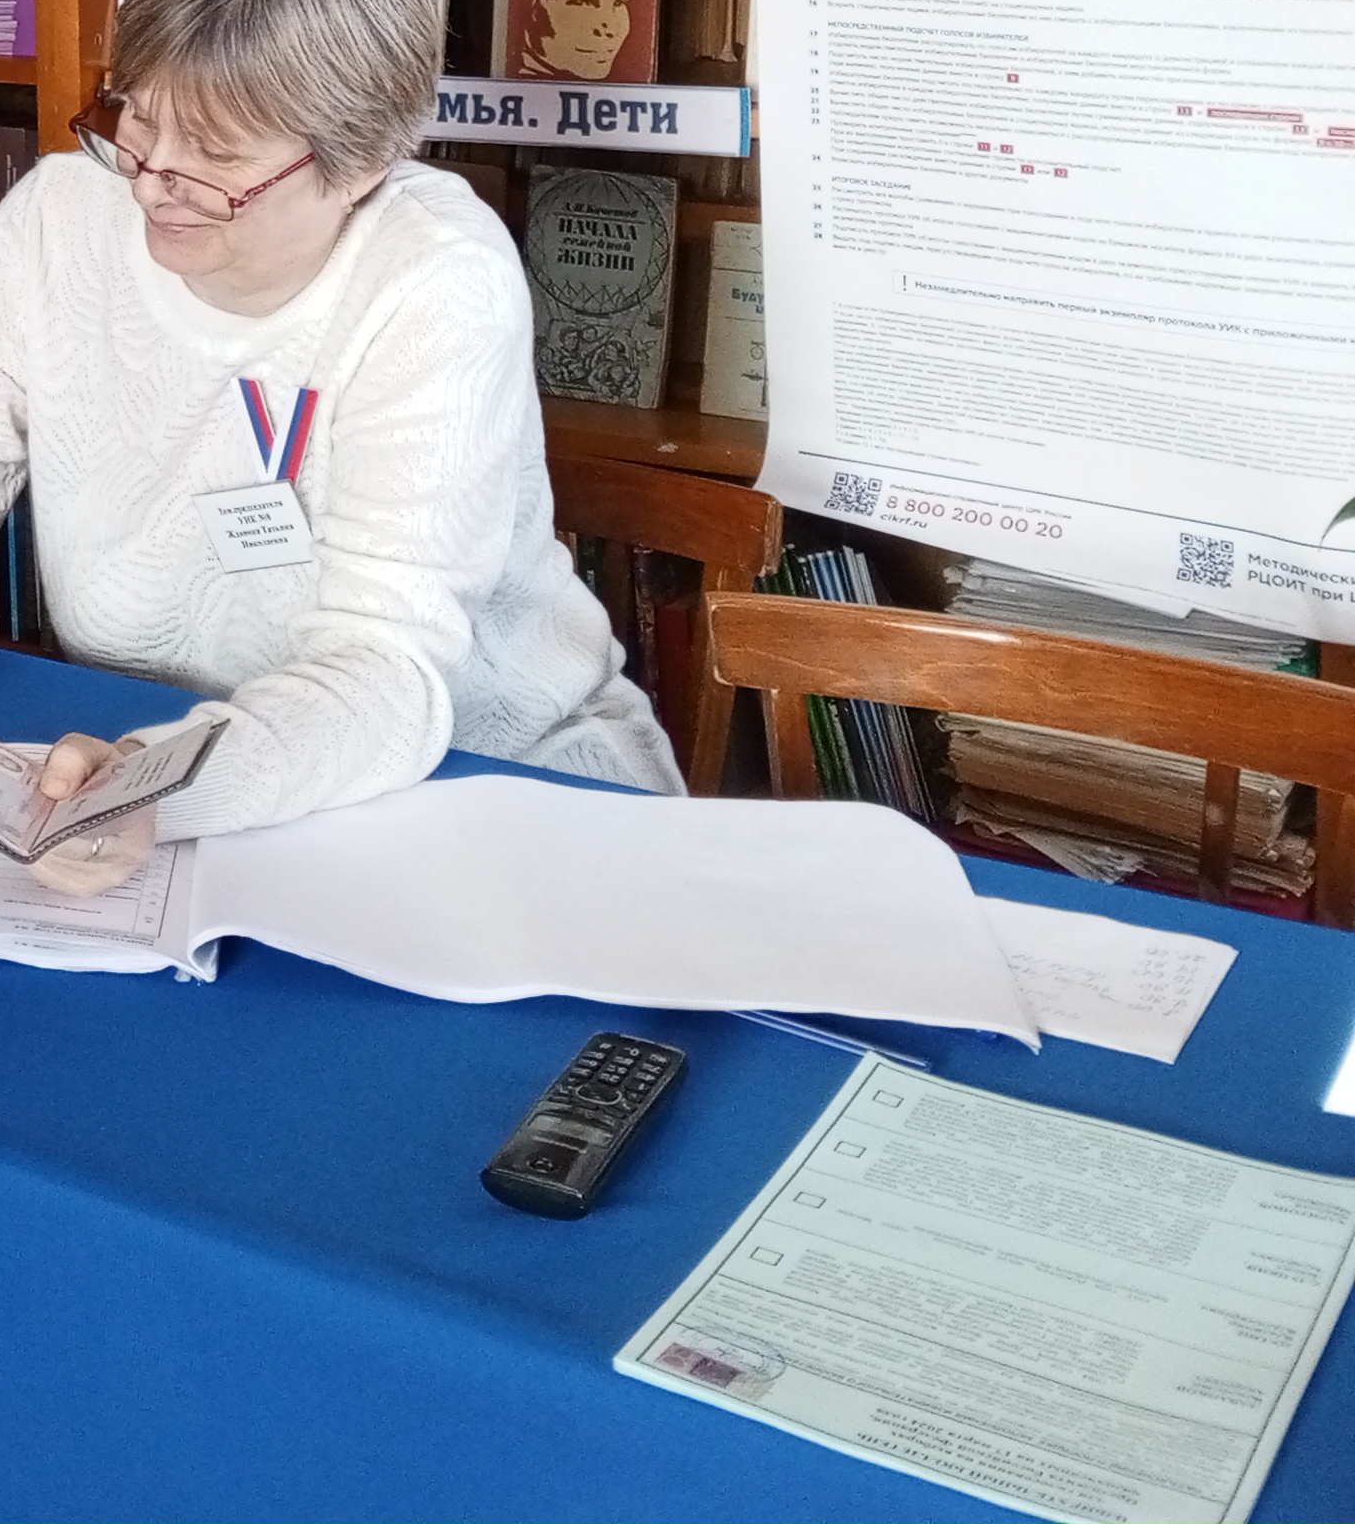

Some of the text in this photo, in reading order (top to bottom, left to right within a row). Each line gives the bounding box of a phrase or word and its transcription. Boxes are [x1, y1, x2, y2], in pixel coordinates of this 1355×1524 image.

[437, 90, 680, 136] мья. Дети
[558, 217, 639, 241] НАЧАЛА
[557, 248, 636, 272] ЖИЗНИ
[880, 513, 928, 529] cikrf.ru
[886, 496, 1063, 539] 8 800 200 00 20
[1248, 570, 1343, 601] РЦОИТ при
